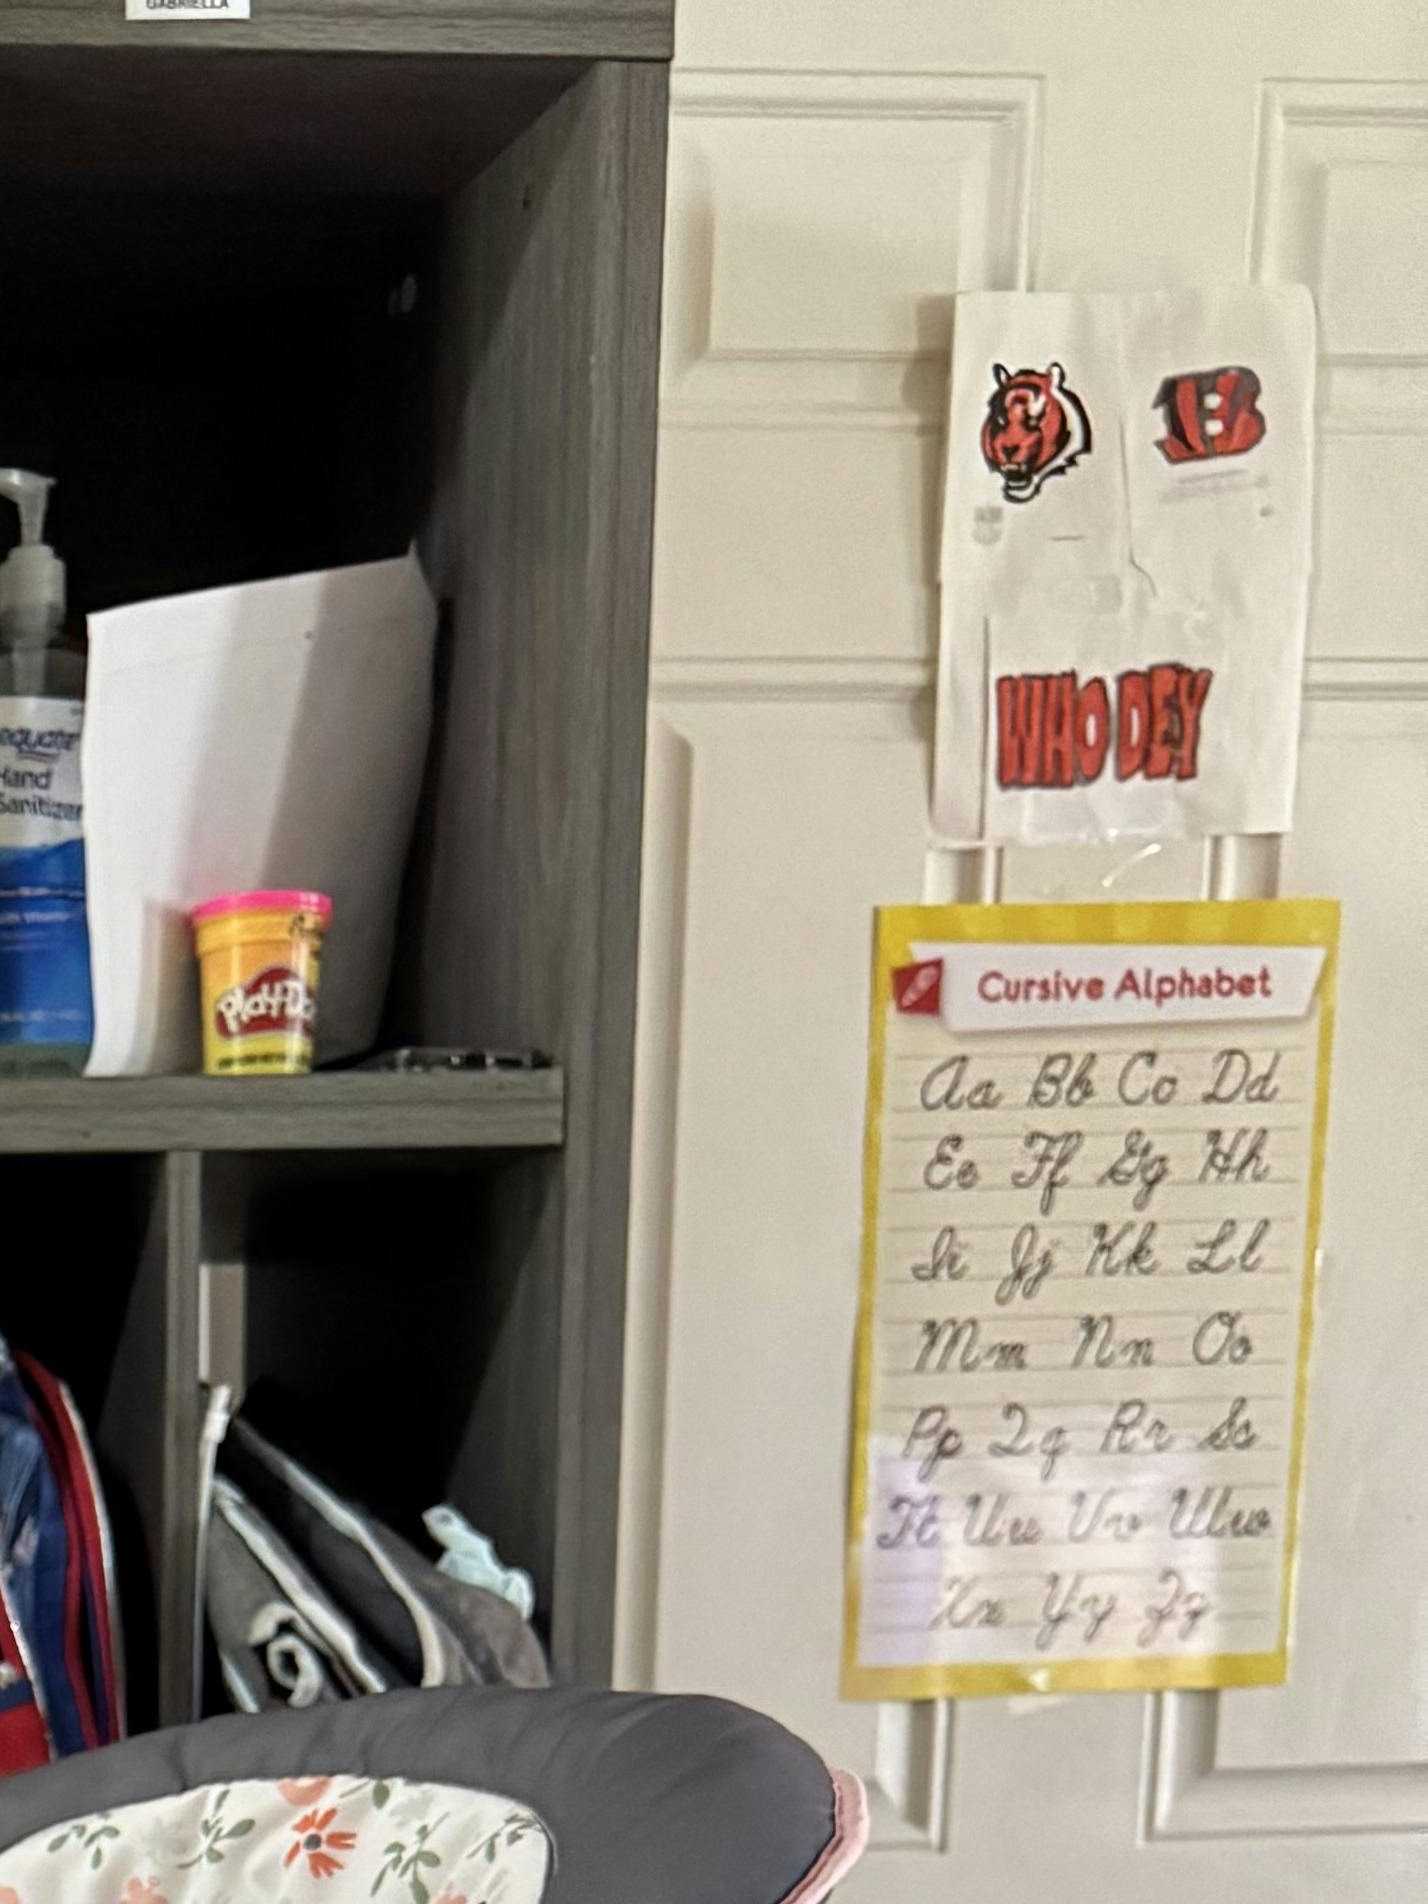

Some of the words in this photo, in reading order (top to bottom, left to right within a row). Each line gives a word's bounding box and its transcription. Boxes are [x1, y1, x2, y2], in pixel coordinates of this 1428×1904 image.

[995, 668, 1110, 790] WHO
[1113, 663, 1214, 782] DEY
[977, 969, 1105, 1004] Cursive
[1114, 963, 1274, 1009] Alphabet
[919, 1055, 1004, 1111] Aa
[1027, 1050, 1098, 1109] Bb
[1201, 1048, 1281, 1105] Dd
[922, 1134, 981, 1190] Ee
[1010, 1130, 1084, 1216] Ff
[1097, 1128, 1169, 1213] Gg
[1197, 1126, 1271, 1184] Hh
[910, 1225, 970, 1282] Ii
[994, 1223, 1060, 1306] Jj
[1083, 1221, 1160, 1276] Kk
[1185, 1217, 1271, 1276] Ll
[913, 1316, 1029, 1374] Mm
[1070, 1313, 1155, 1369] Nn
[1190, 1309, 1255, 1367] Oo
[900, 1405, 964, 1483] Pp
[1098, 1398, 1177, 1454] Rr
[875, 1493, 941, 1550] Tt
[961, 1492, 1044, 1548] Uu
[1066, 1488, 1144, 1544] Vv
[1169, 1485, 1271, 1540] Ww
[932, 1577, 1006, 1629] Xx
[1034, 1572, 1118, 1650] Yy
